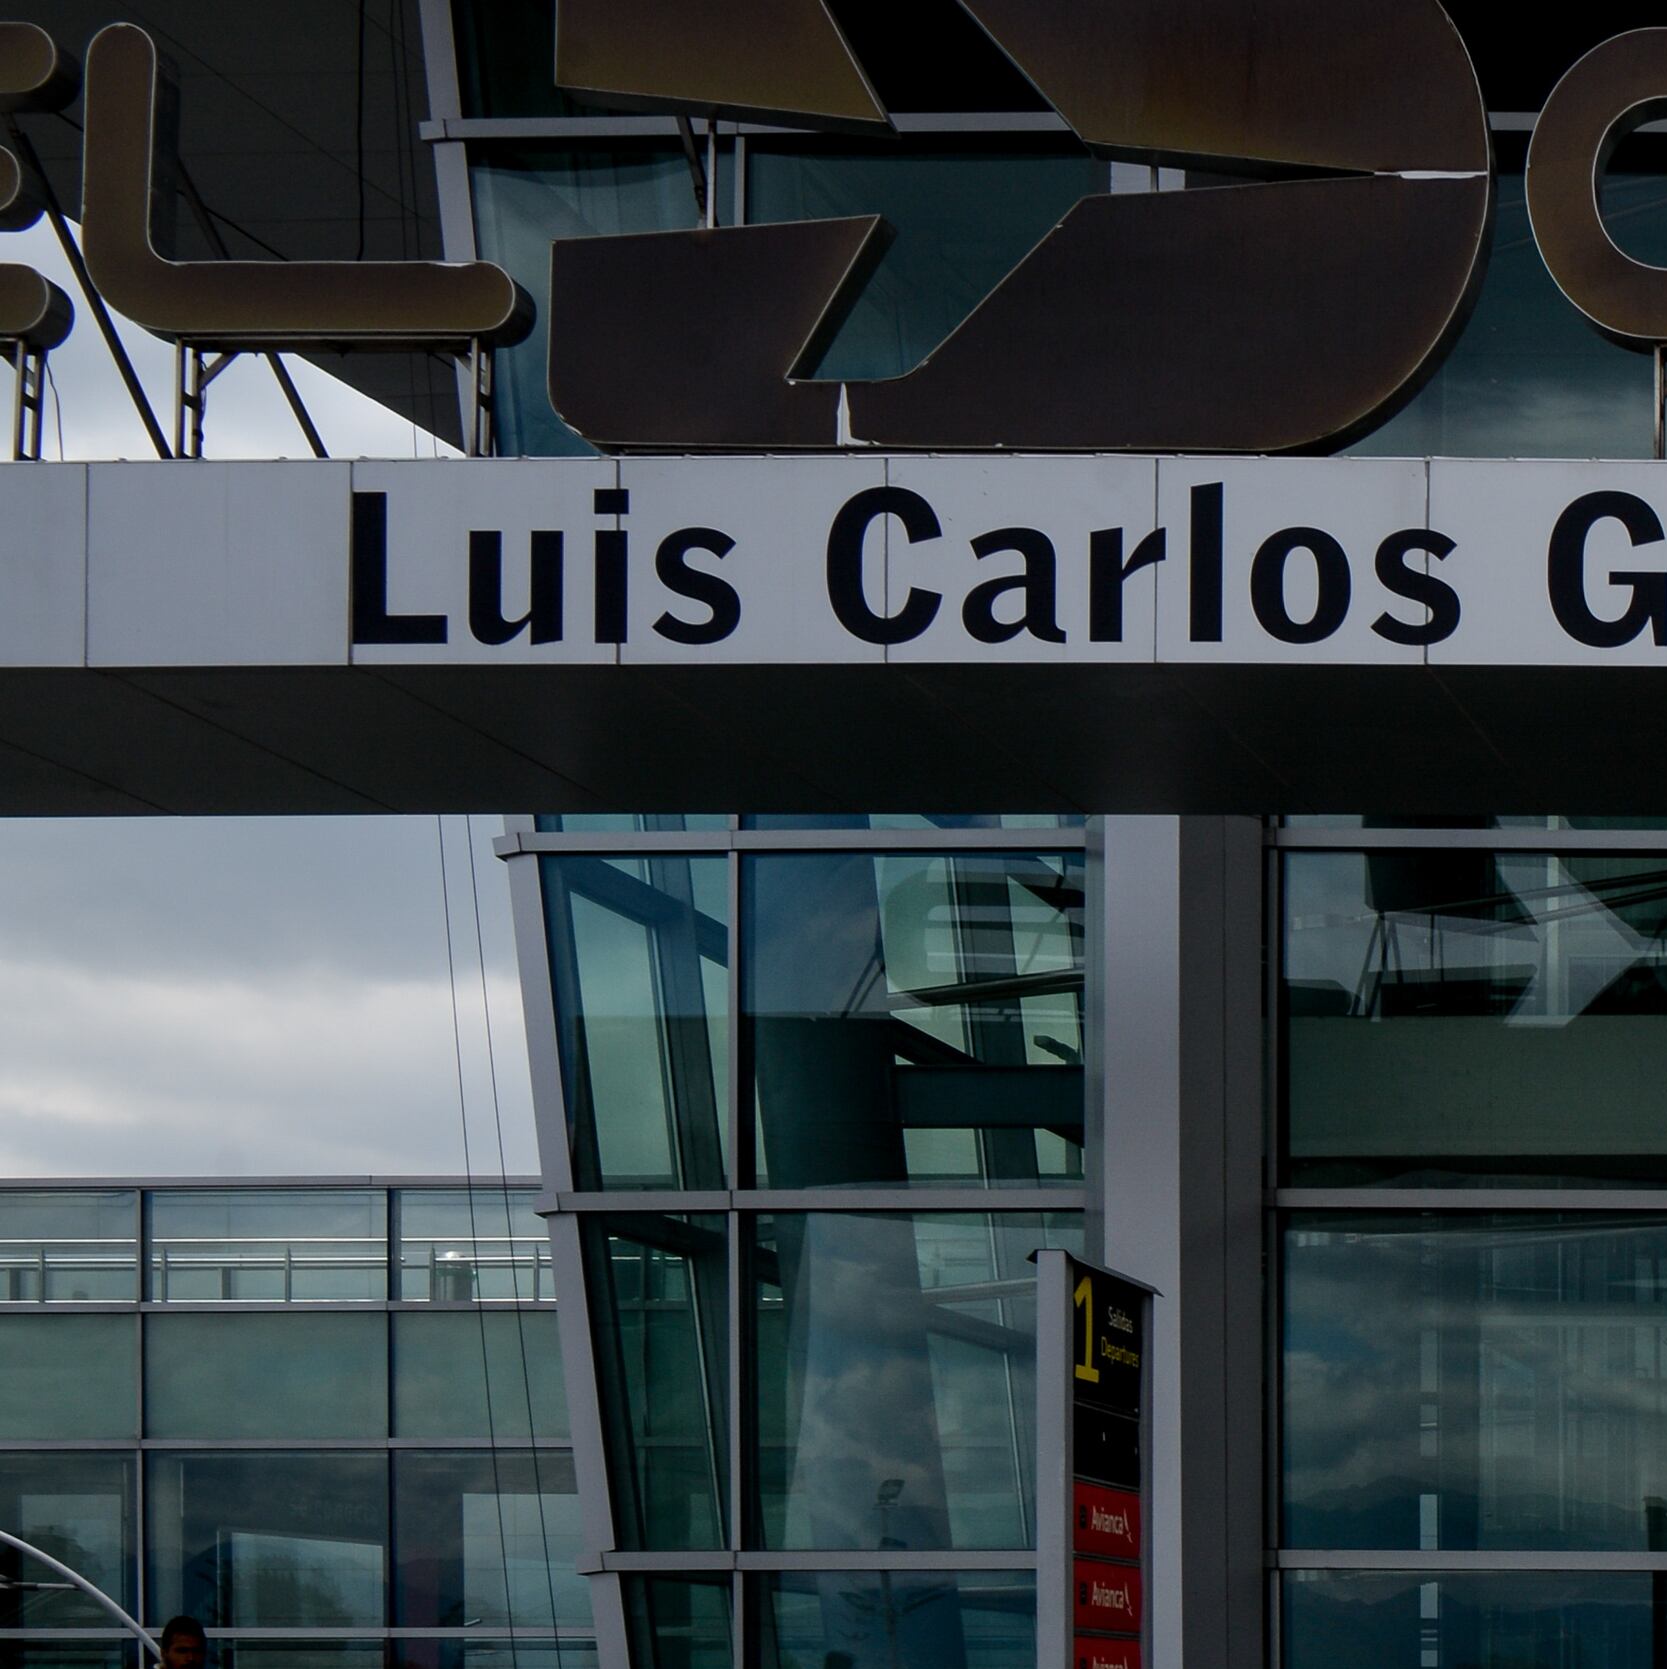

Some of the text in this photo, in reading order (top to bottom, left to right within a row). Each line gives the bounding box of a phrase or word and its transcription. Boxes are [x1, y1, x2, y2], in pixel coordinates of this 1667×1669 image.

[0, 22, 535, 349] L
[352, 487, 741, 646] Luis
[827, 481, 1460, 648] Carlos
[1074, 1275, 1100, 1384] 1
[1107, 1306, 1134, 1334] Salidas
[1101, 1336, 1139, 1369] Departures
[1091, 1505, 1124, 1536] Avianca
[1091, 1581, 1124, 1610] Avianca
